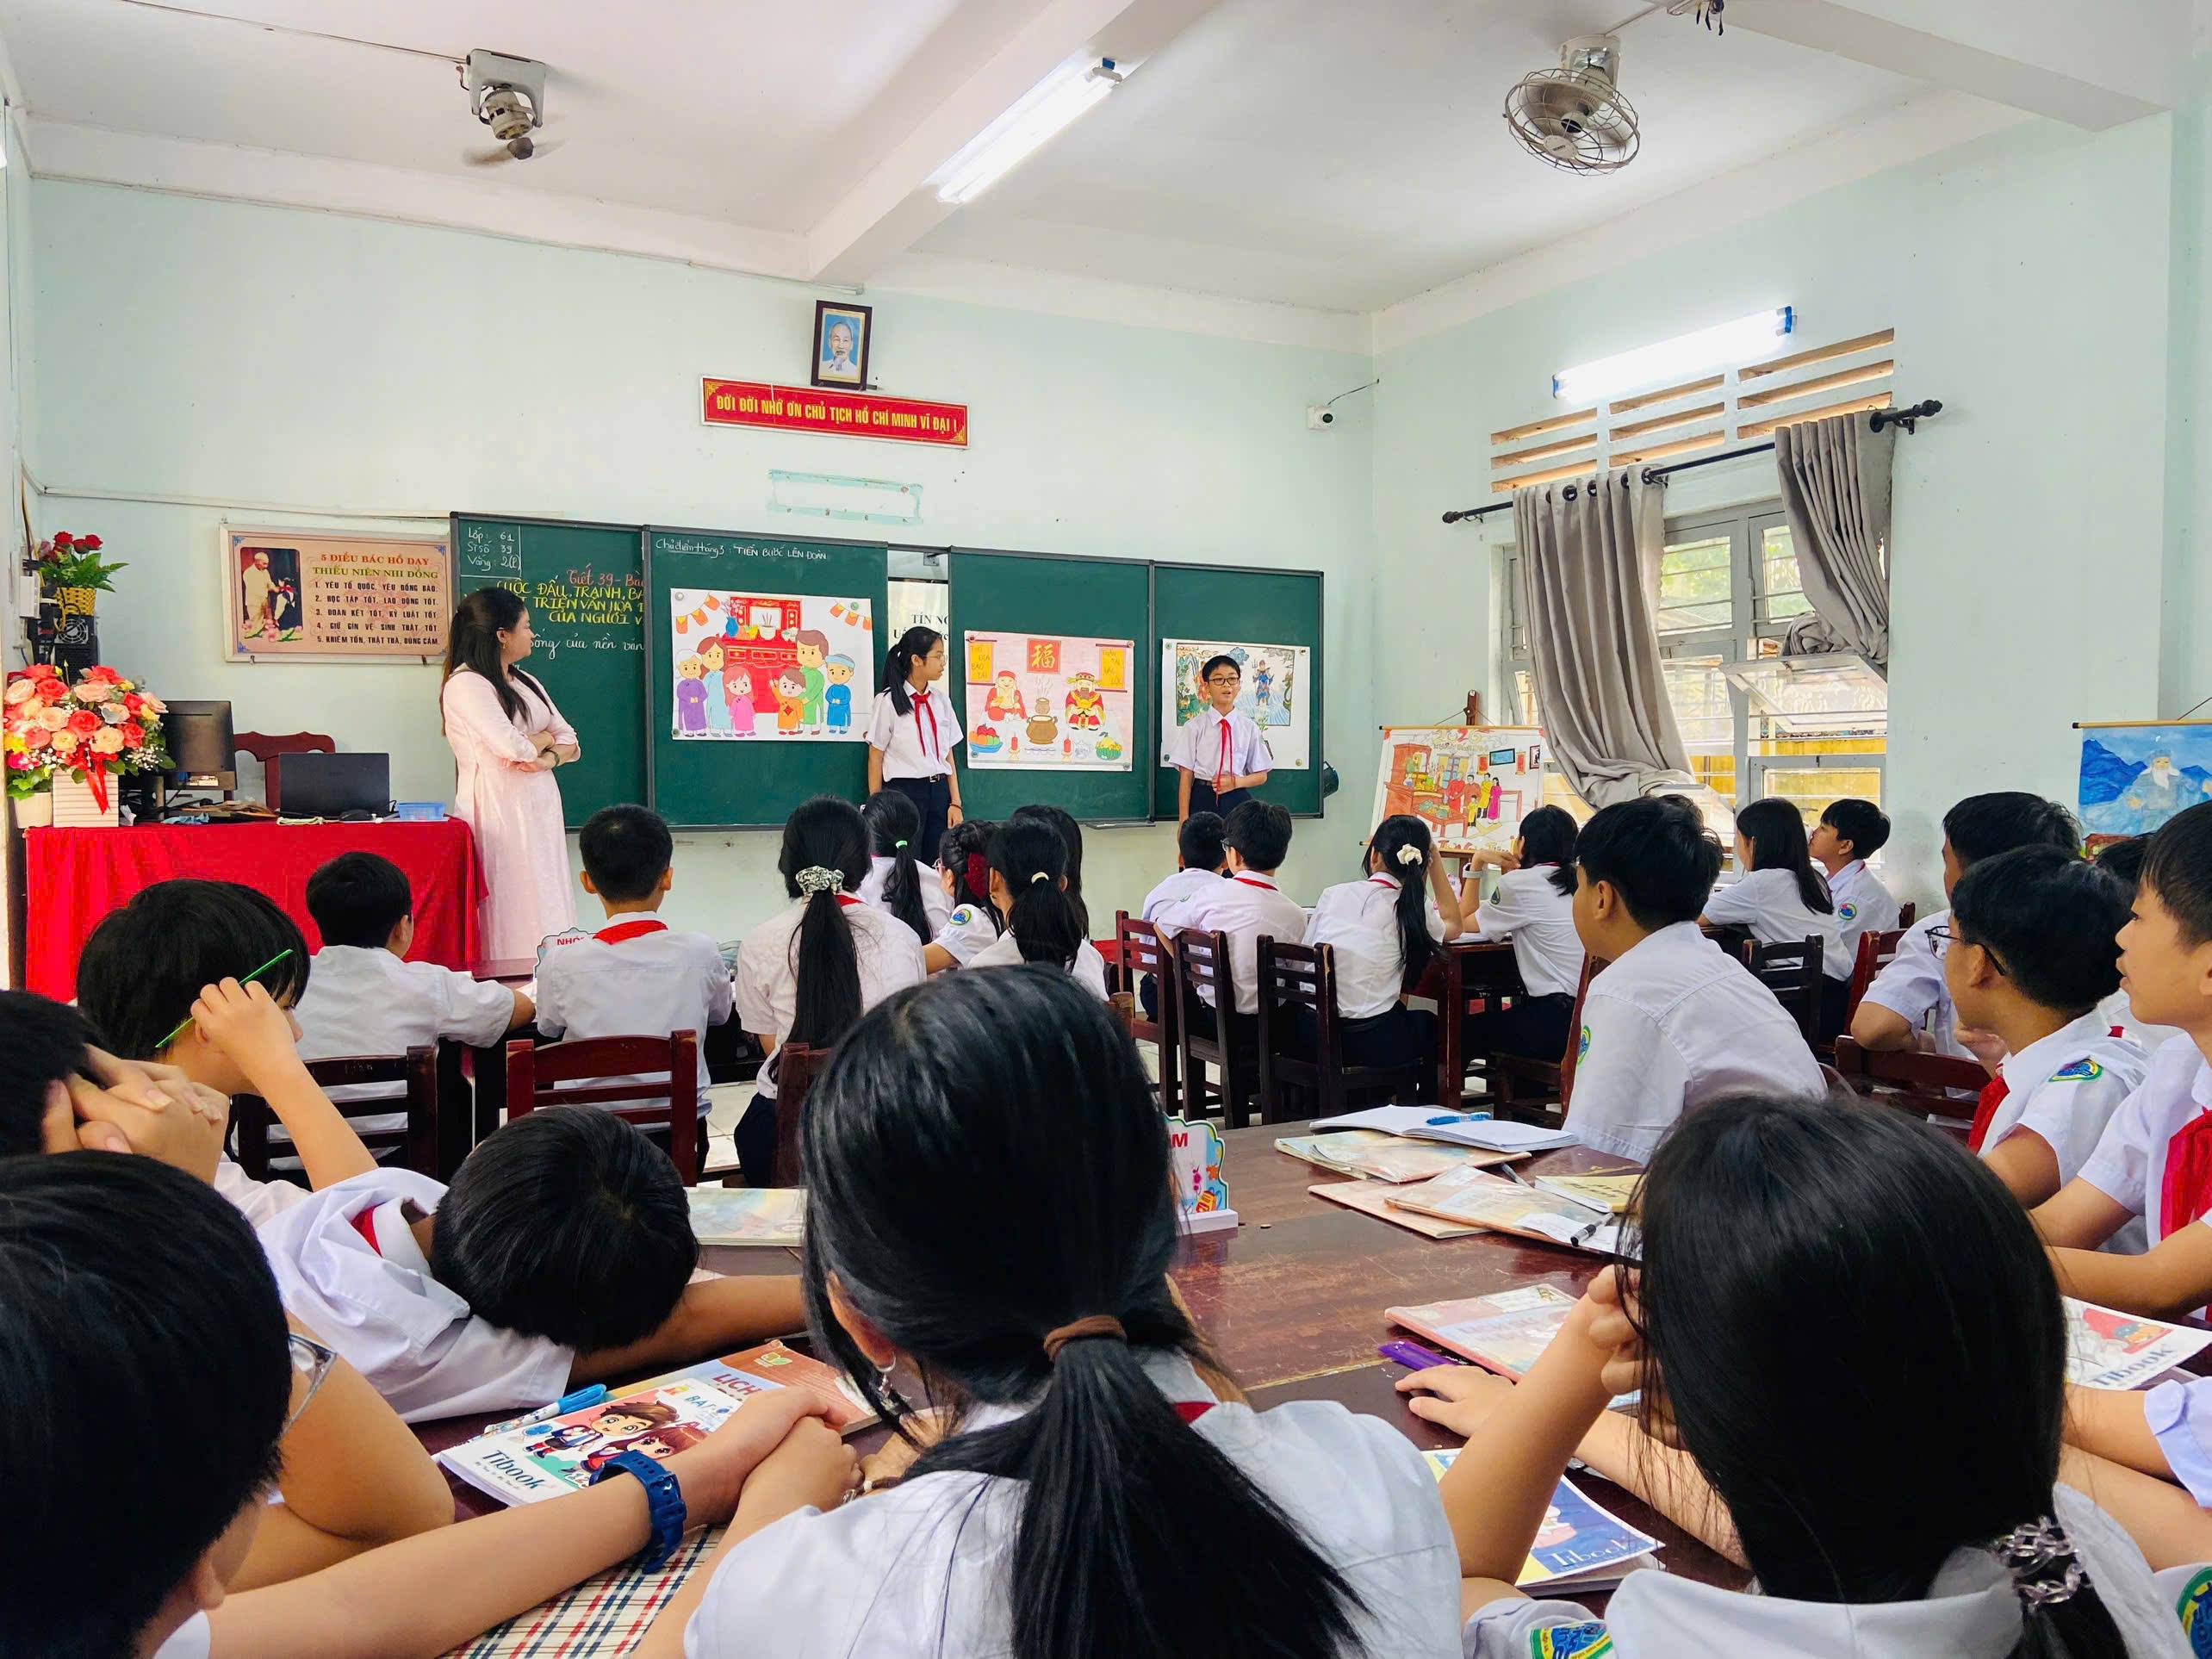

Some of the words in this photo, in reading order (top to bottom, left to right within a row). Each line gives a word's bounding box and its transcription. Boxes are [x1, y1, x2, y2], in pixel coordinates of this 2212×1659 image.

[717, 393, 736, 411] ĐỜI
[739, 395, 758, 413] ĐỜI
[761, 398, 783, 415] NHỚ
[786, 401, 802, 418] ƠN
[805, 401, 826, 420] CHỦ
[829, 407, 852, 424] TỊCH
[855, 404, 869, 424] HỒ
[873, 409, 889, 426] CHÍ
[892, 413, 916, 428] MINH
[920, 413, 930, 430] VĨ
[933, 416, 950, 434] ĐẠI
[500, 544, 513, 555] 39
[787, 547, 804, 558] LÊN
[362, 554, 384, 563] BÁC
[566, 633, 587, 649] của
[593, 632, 617, 649] nền
[1031, 643, 1056, 670] 福
[482, 1450, 545, 1489] Tibook
